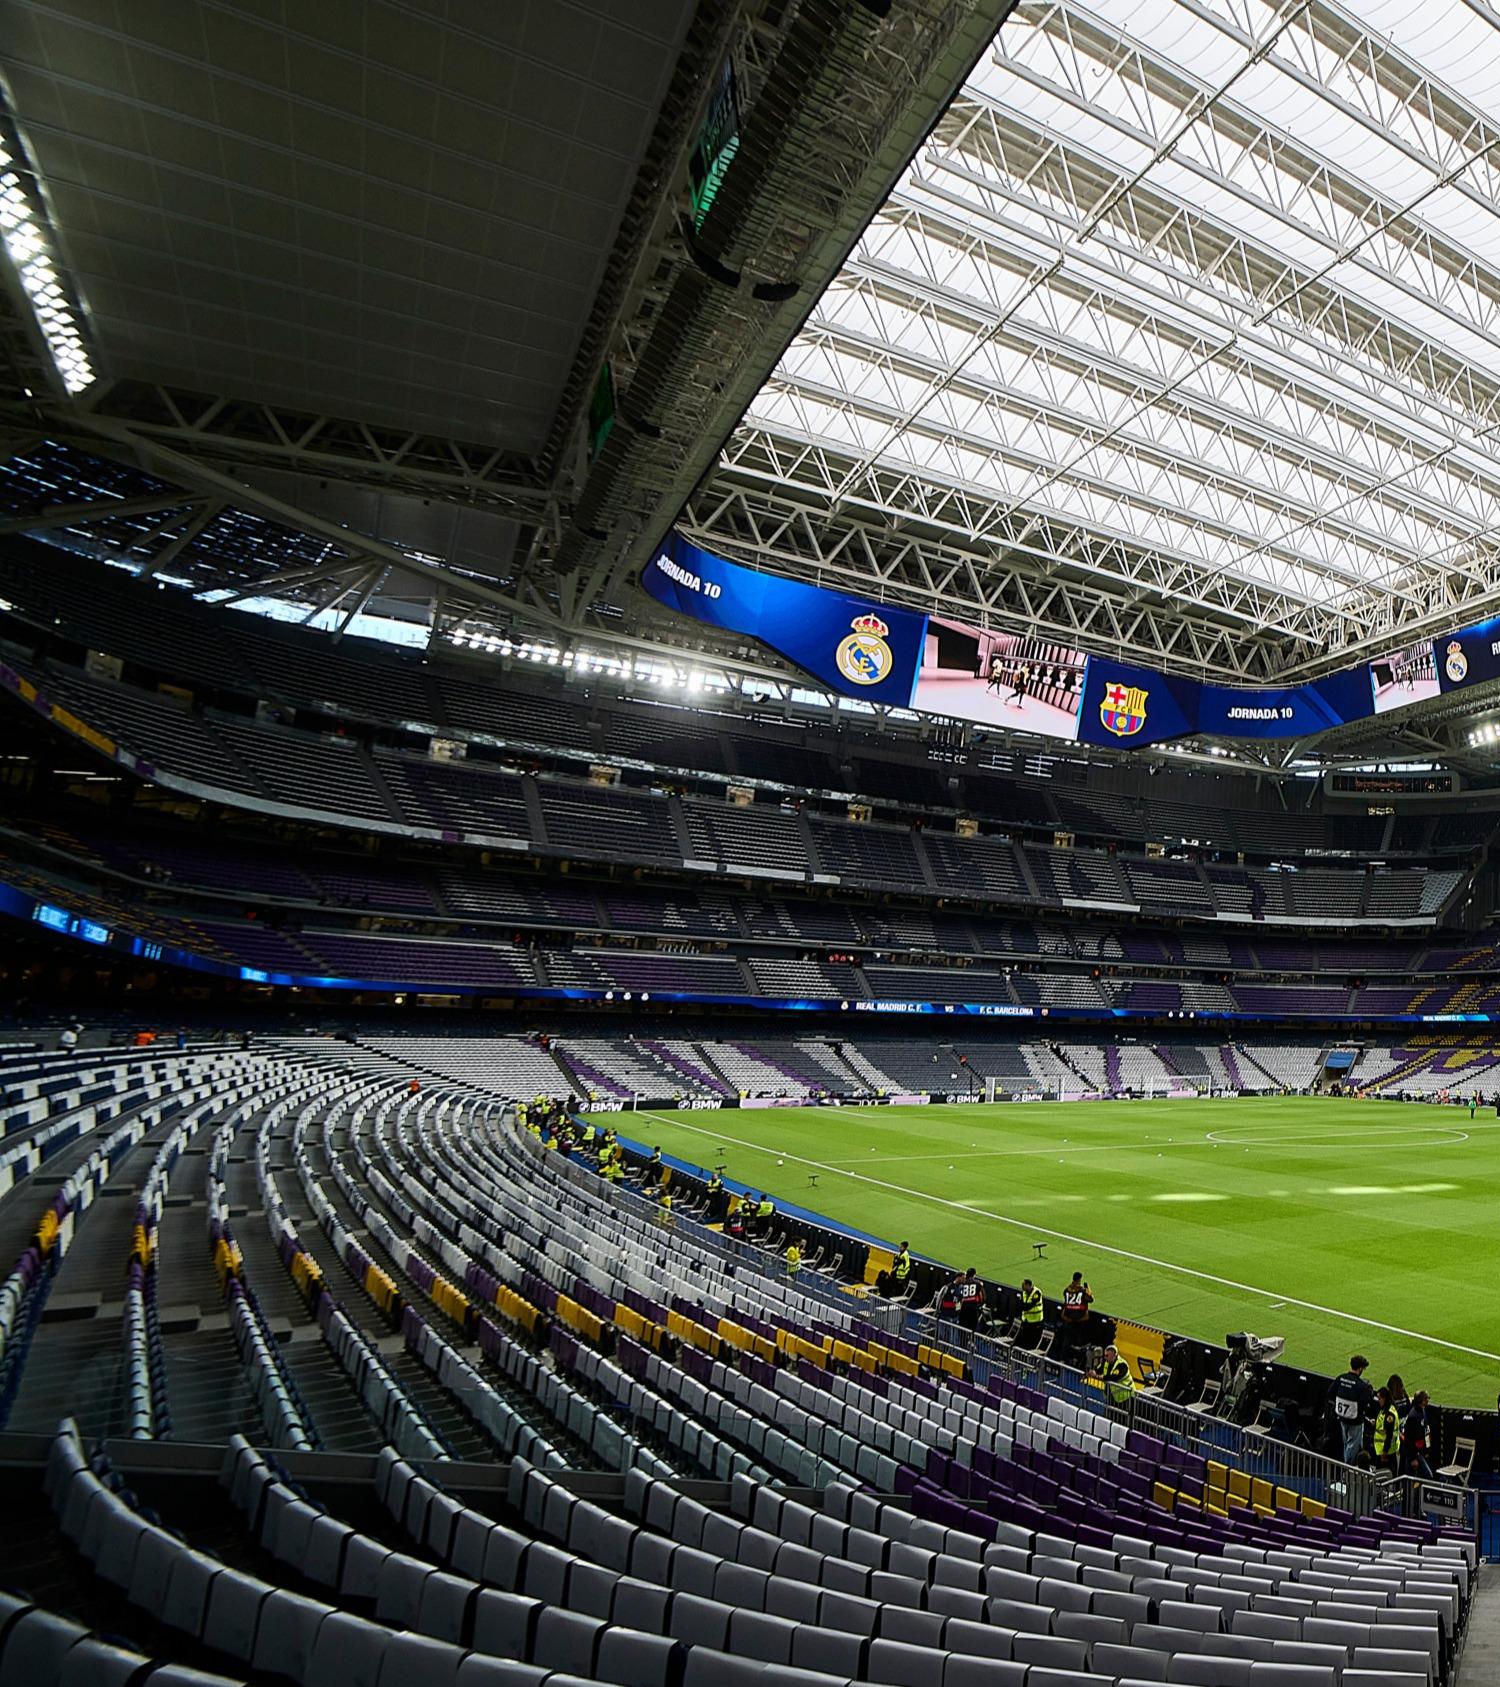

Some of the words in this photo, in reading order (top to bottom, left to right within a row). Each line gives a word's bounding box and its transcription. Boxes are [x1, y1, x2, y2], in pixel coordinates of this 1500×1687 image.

[656, 554, 701, 592] JORNADA
[703, 582, 721, 598] 10
[1227, 707, 1279, 719] JORNADA
[1280, 707, 1293, 718] 10
[856, 1002, 875, 1011] REAL
[876, 1003, 907, 1012] MADRID
[994, 1007, 1034, 1016] BARCELONA
[957, 1095, 980, 1103] BMW
[1021, 1094, 1043, 1102] BMW
[1220, 1090, 1239, 1098] BMW
[590, 1102, 624, 1112] BMW
[691, 1100, 722, 1110] BMW
[1065, 1292, 1083, 1305] 124
[1337, 1402, 1350, 1415] 67
[1444, 1497, 1454, 1506] 110
